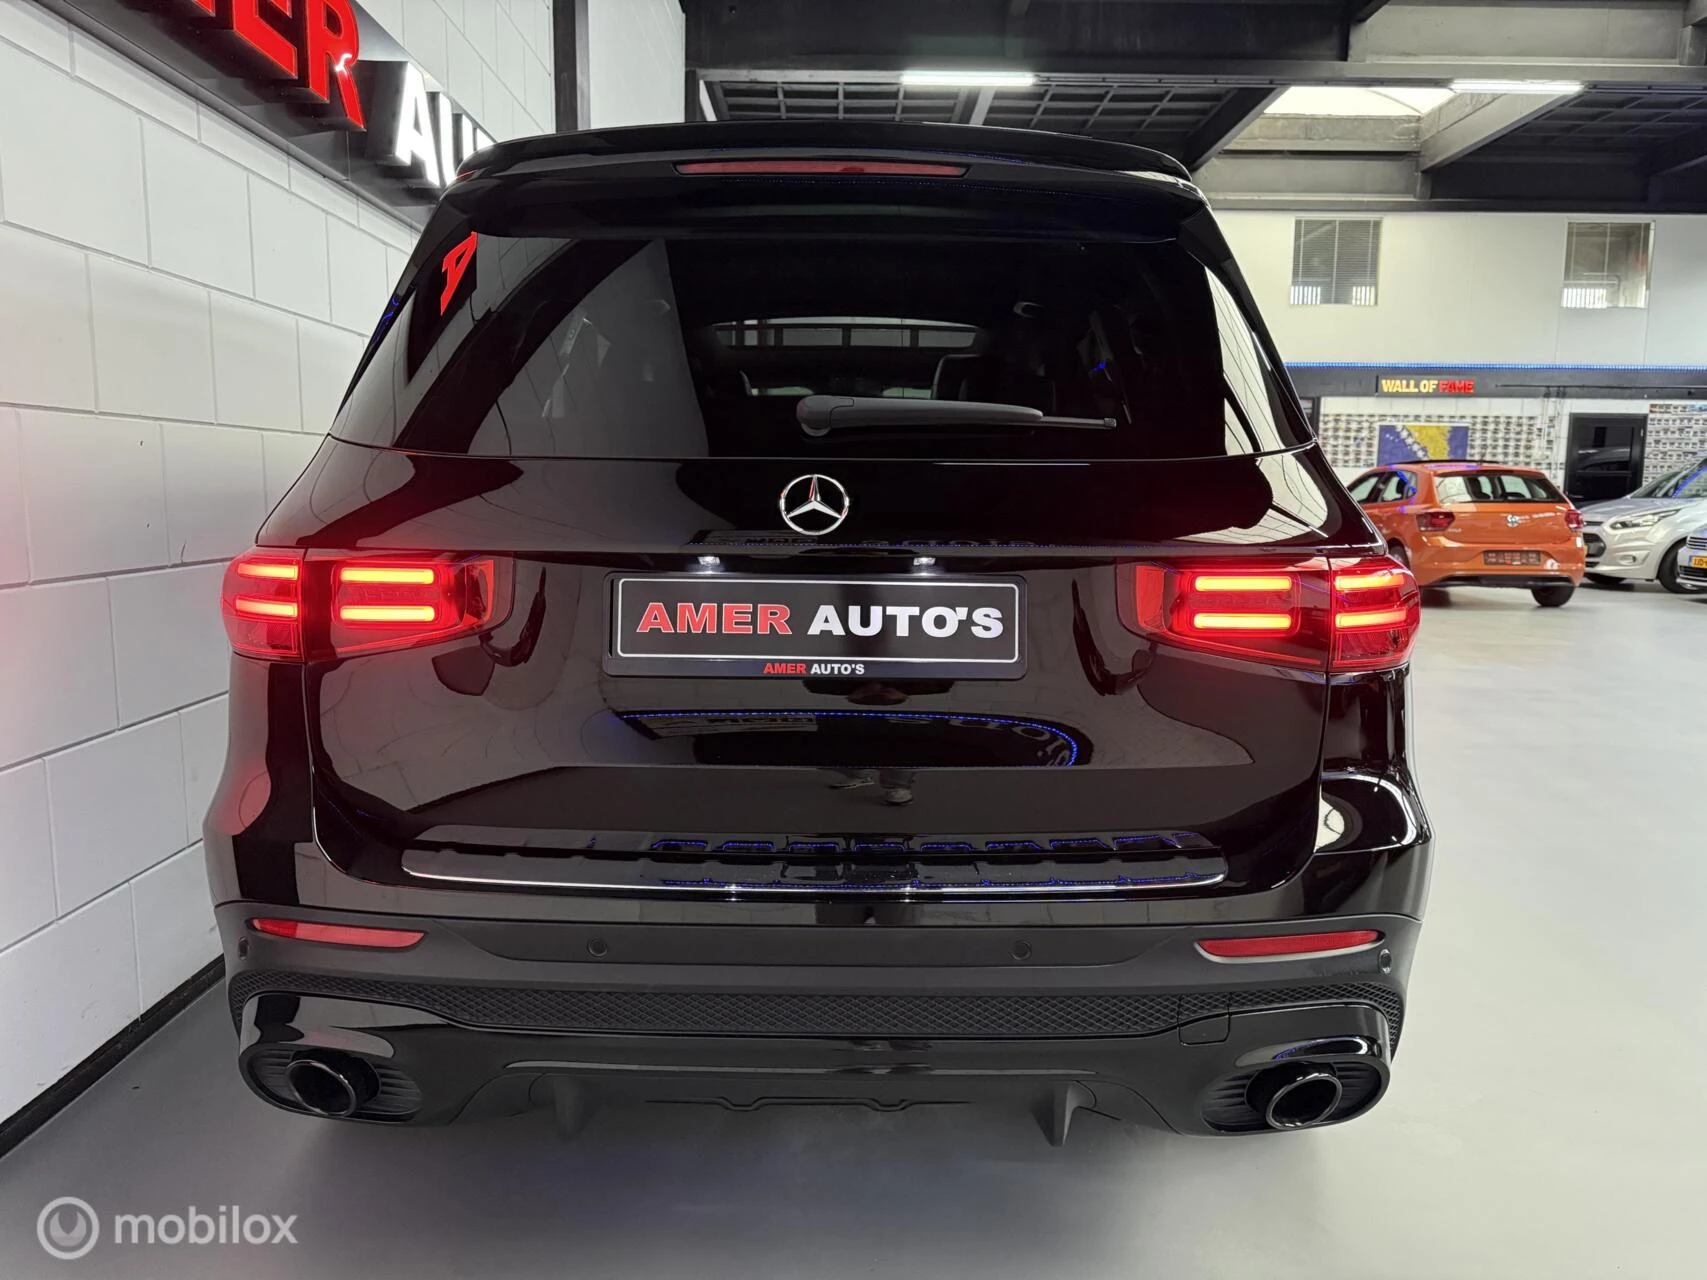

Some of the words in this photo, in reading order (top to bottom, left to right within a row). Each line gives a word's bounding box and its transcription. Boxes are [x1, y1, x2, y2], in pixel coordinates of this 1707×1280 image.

[1381, 379, 1419, 393] WALL
[1419, 379, 1438, 393] OF
[1439, 379, 1474, 393] FAME
[636, 602, 792, 635] AMER
[807, 604, 1004, 639] AUTO'S
[763, 662, 807, 675] AMER
[810, 662, 865, 675] AUTO'S
